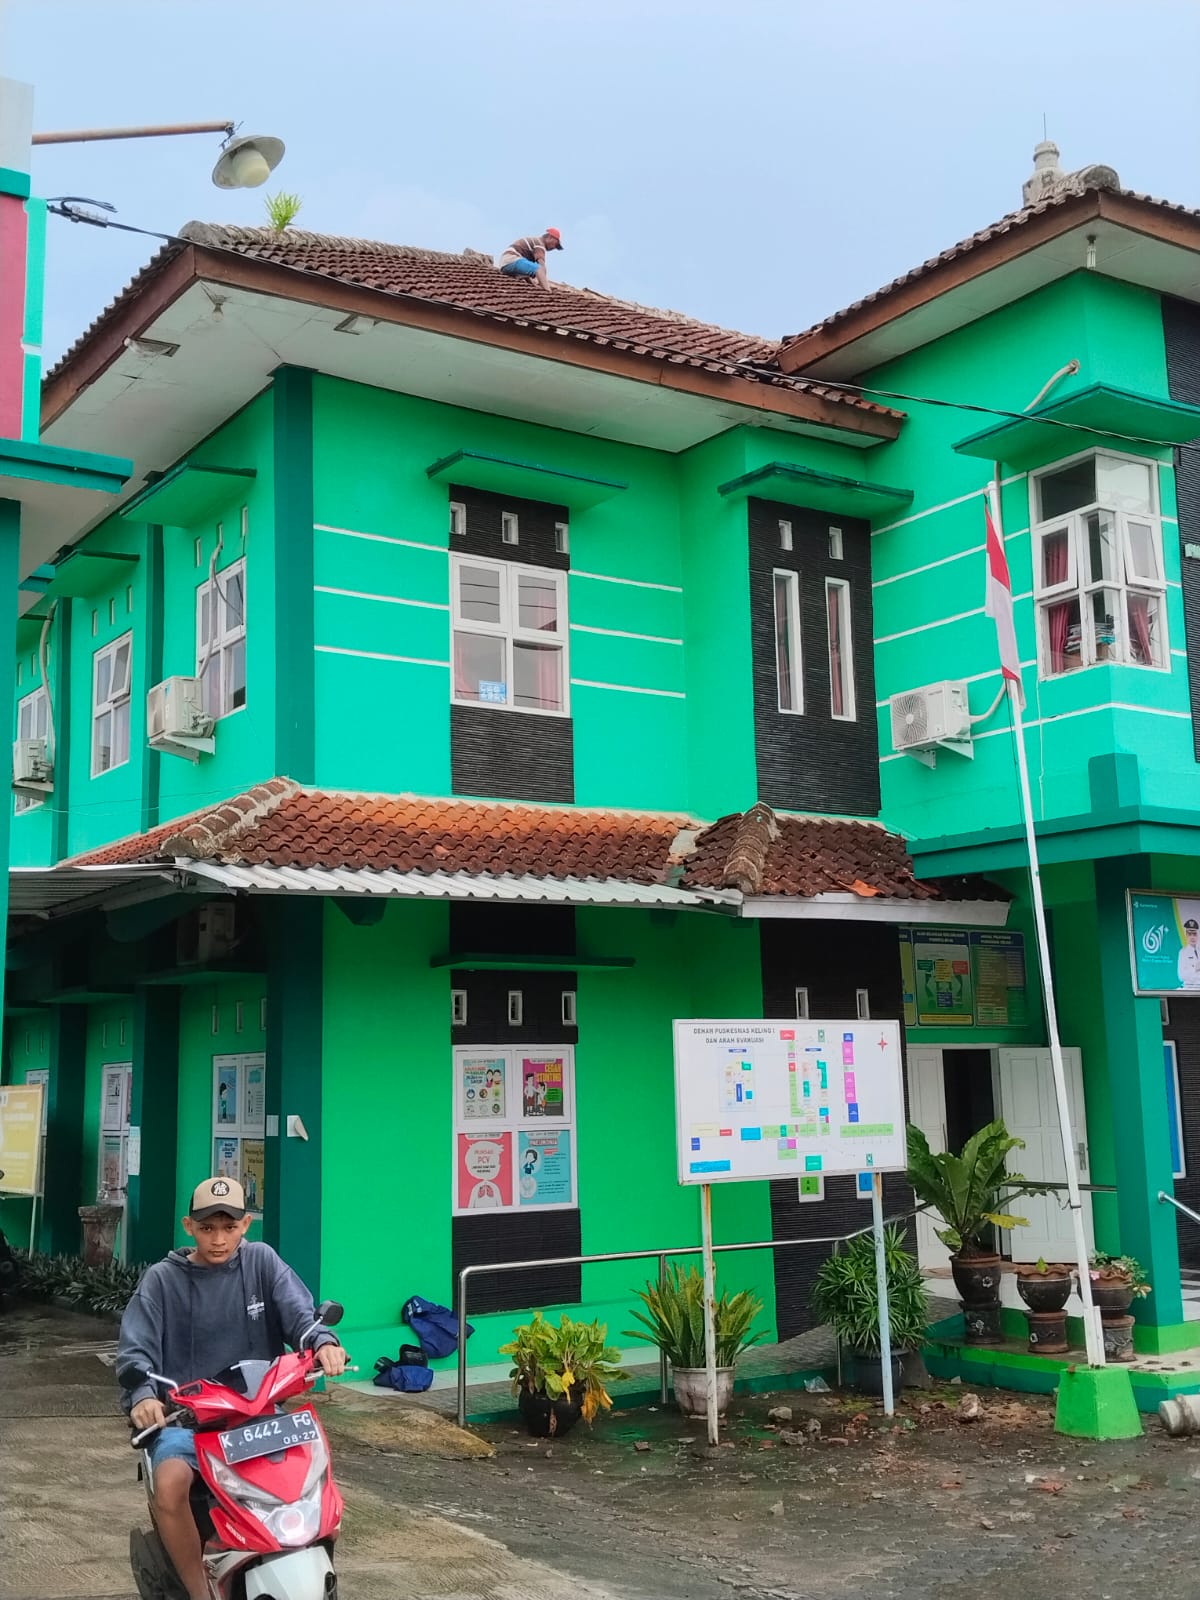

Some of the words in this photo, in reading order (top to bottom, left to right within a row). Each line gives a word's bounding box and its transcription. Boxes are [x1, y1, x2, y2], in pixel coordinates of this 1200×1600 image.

[221, 1434, 233, 1448] K
[243, 1421, 282, 1442] 6442
[291, 1413, 312, 1428] FG
